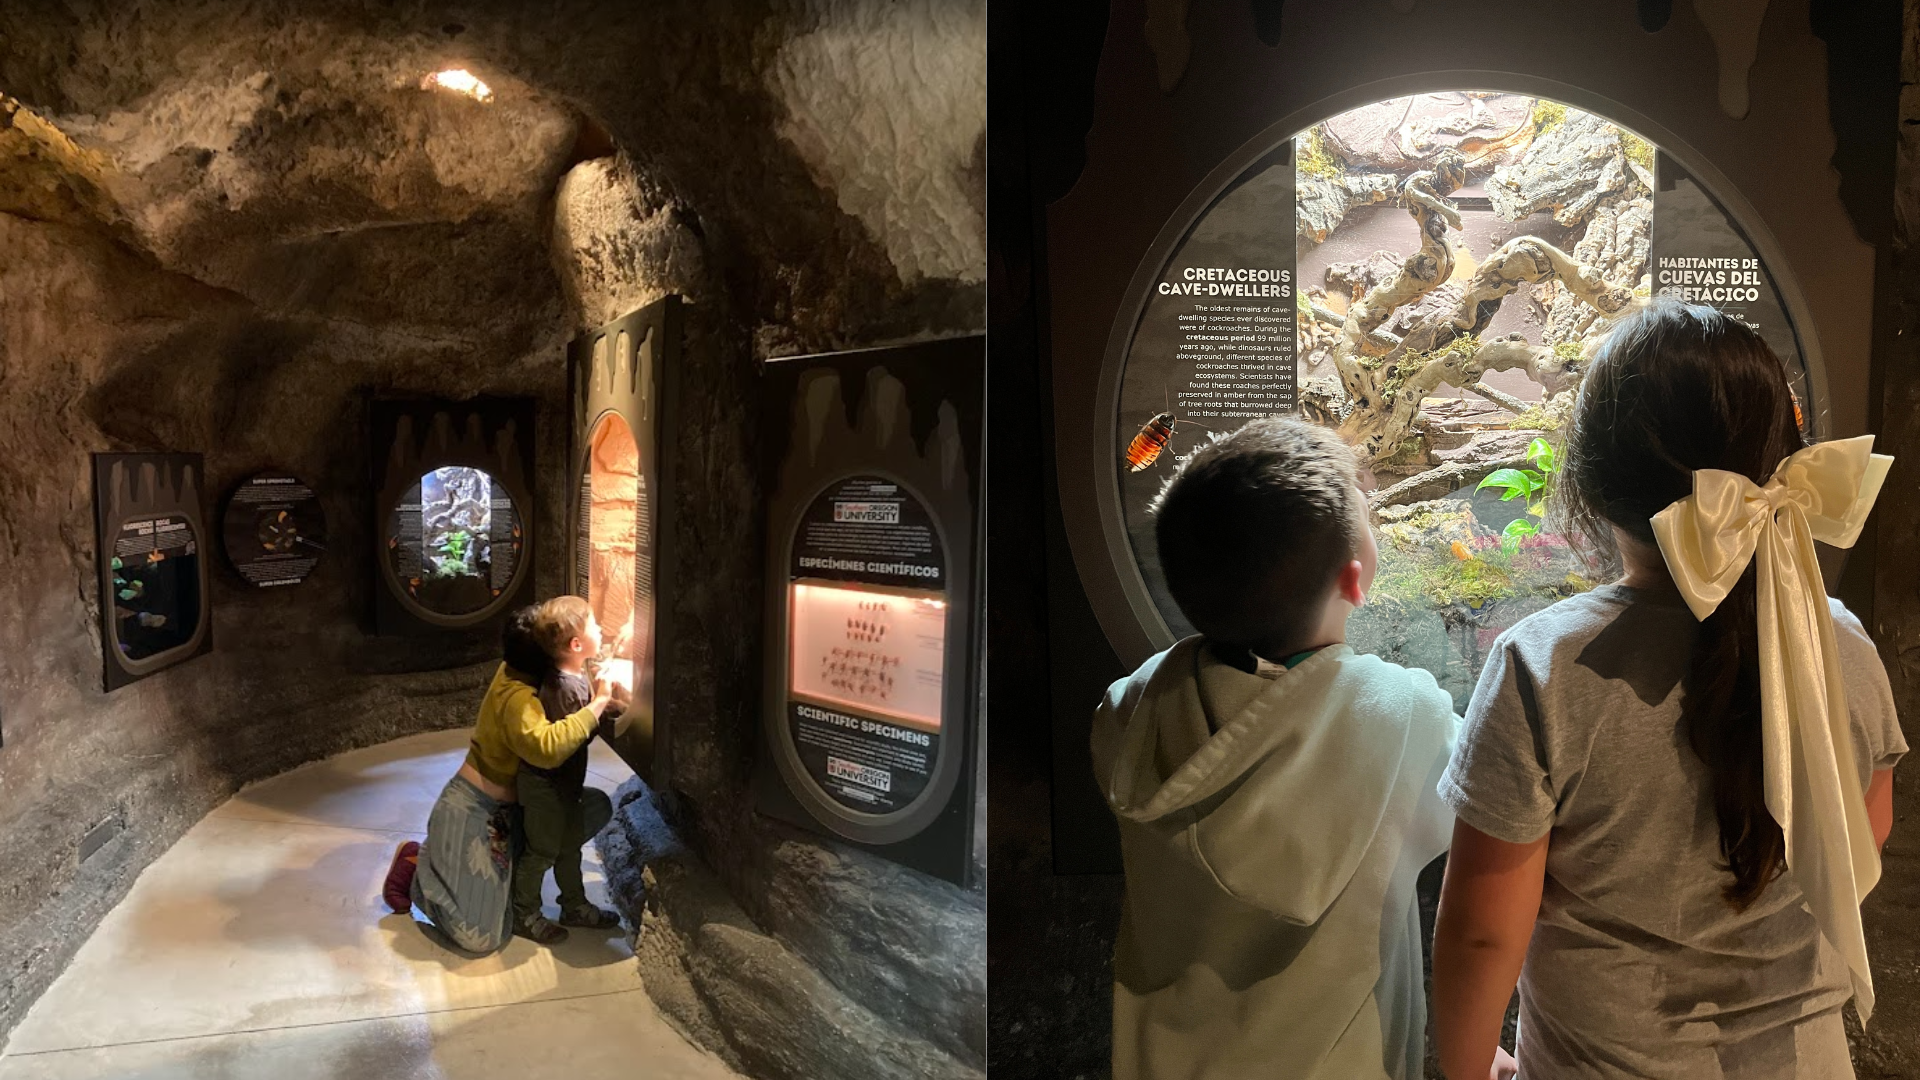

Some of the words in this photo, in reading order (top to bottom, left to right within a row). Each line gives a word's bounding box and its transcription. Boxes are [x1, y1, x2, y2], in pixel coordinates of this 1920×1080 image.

[1659, 258, 1738, 270] HABITANTES
[1742, 258, 1758, 270] DE
[1183, 268, 1290, 282] CRETACEOUS
[1658, 270, 1726, 285] CUEVAS
[1731, 271, 1761, 286] DEL
[1158, 282, 1291, 298] CAVE-DWELLERS
[844, 511, 897, 521] UNIVERSITY
[800, 556, 865, 572] ESPECÍMENES
[867, 561, 939, 578] CIENTÍFICOS
[797, 706, 859, 729] SCIENTIFIC
[861, 721, 930, 746] SPECIMENS
[837, 767, 888, 789] UNIVERSITY
